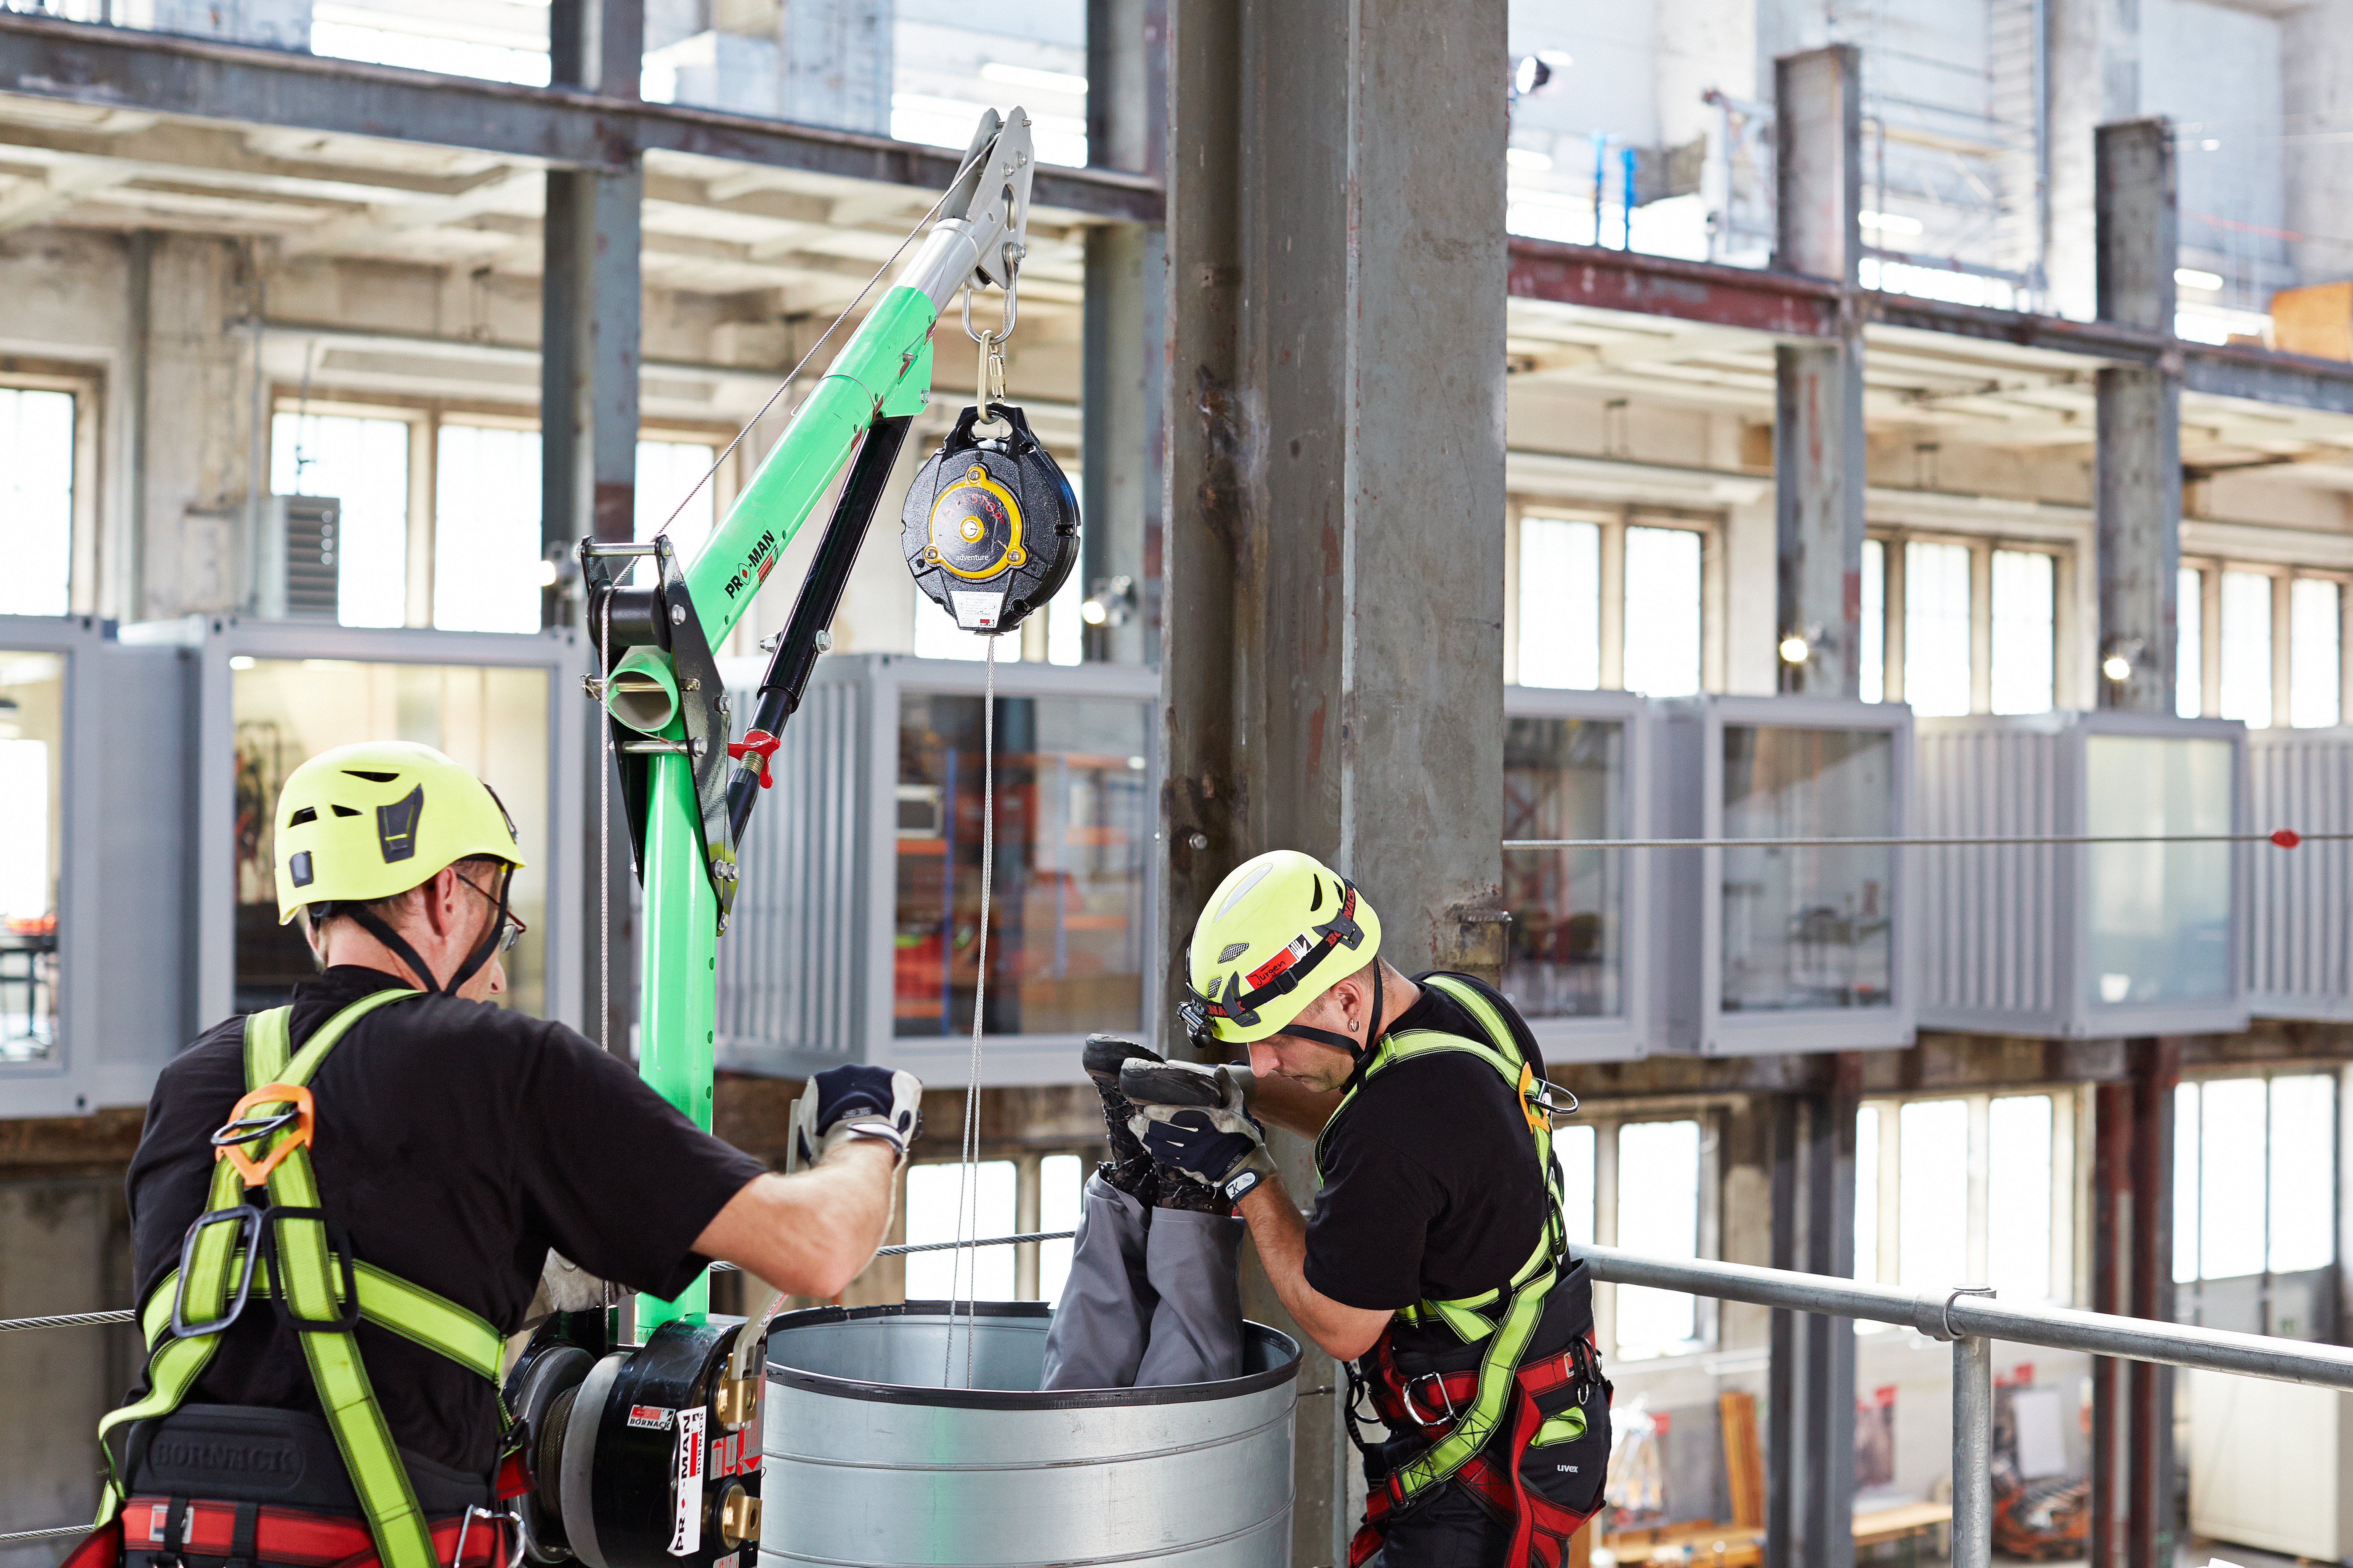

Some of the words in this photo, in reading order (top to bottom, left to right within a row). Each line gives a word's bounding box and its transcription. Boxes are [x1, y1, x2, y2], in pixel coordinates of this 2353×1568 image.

[725, 530, 775, 600] PRO-MAN
[629, 1418, 670, 1428] BORNACK
[673, 1414, 690, 1551] PRO-MAN
[1557, 1464, 1578, 1473] uvex
